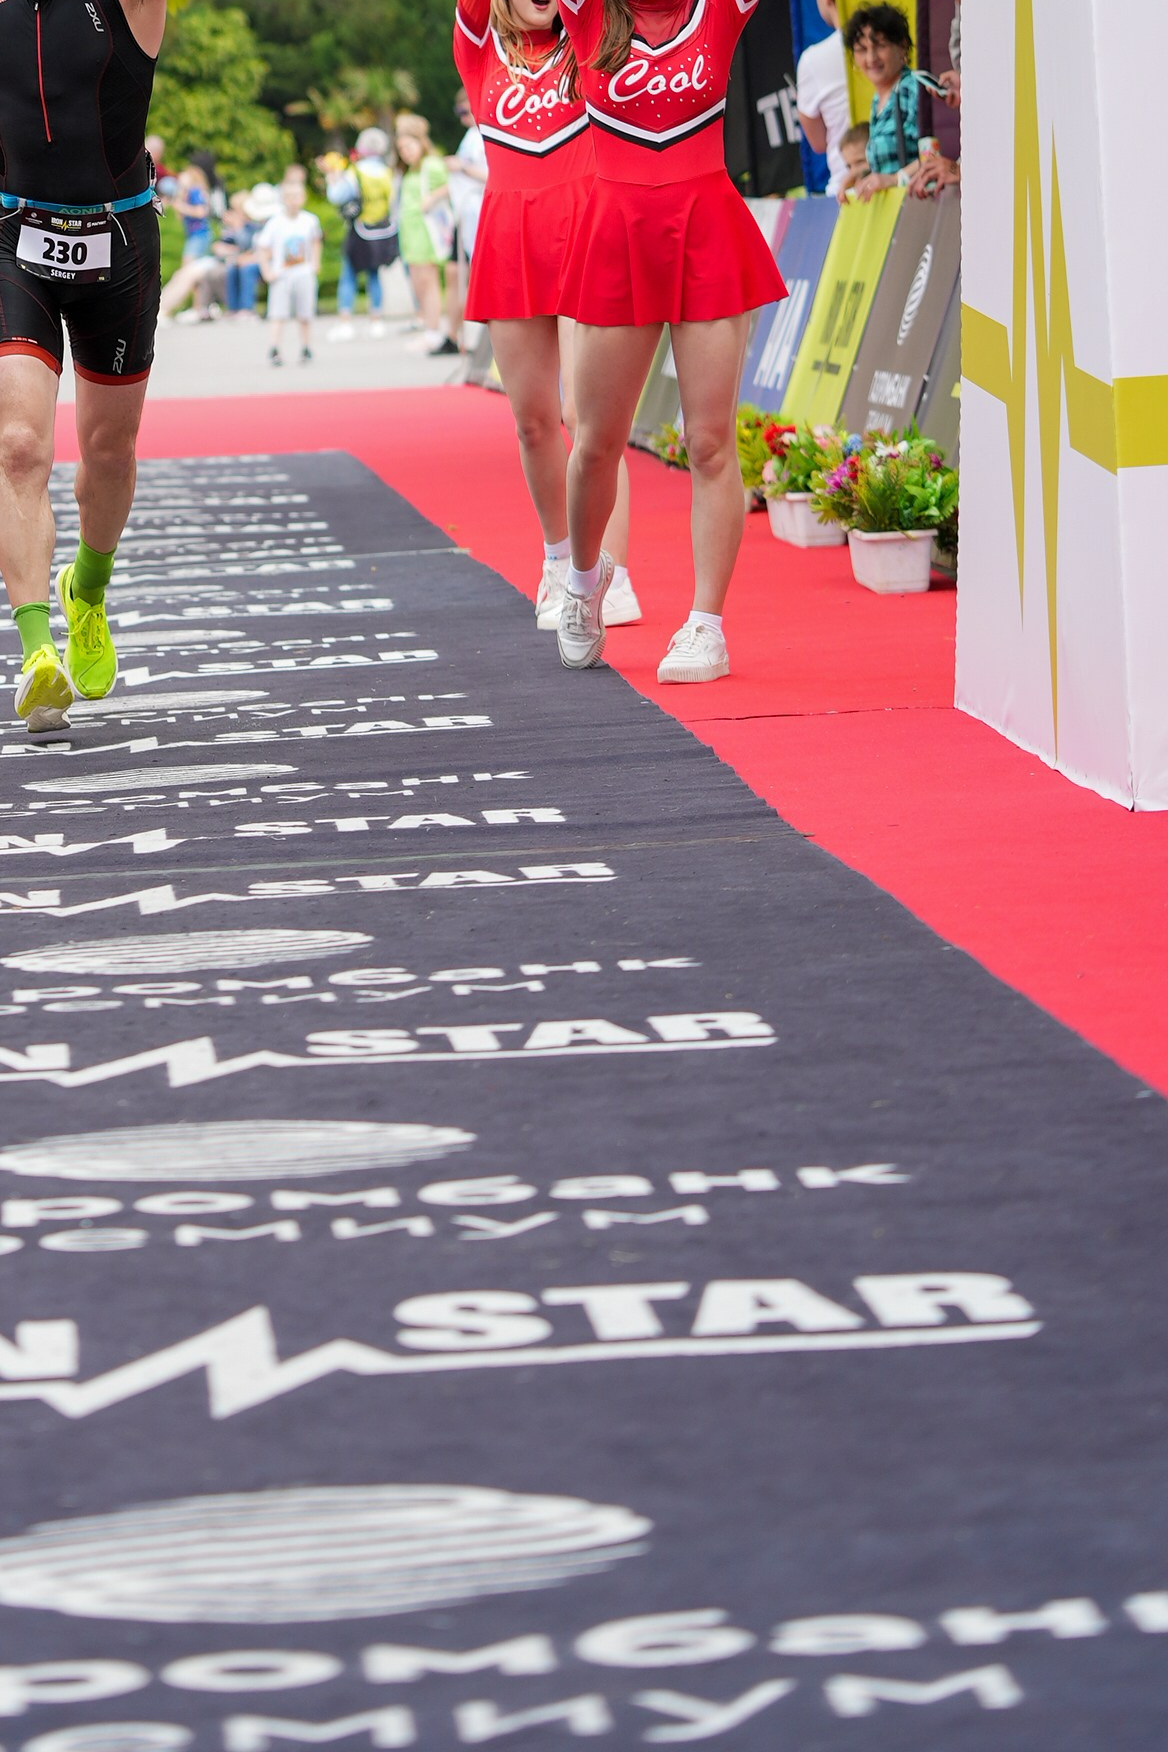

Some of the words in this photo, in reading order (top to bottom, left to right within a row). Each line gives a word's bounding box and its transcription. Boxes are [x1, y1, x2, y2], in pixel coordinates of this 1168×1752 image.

[84, 2, 105, 32] 2XU
[608, 54, 709, 102] Cool
[42, 236, 88, 266] 230
[50, 268, 77, 280] SERGEY
[112, 338, 127, 374] 2XU
[198, 649, 439, 672] STAR
[214, 714, 493, 740] STAR
[233, 808, 567, 838] STAR
[248, 861, 616, 895] STAR
[306, 1011, 775, 1056] STAR
[393, 1271, 1033, 1351] STAR
